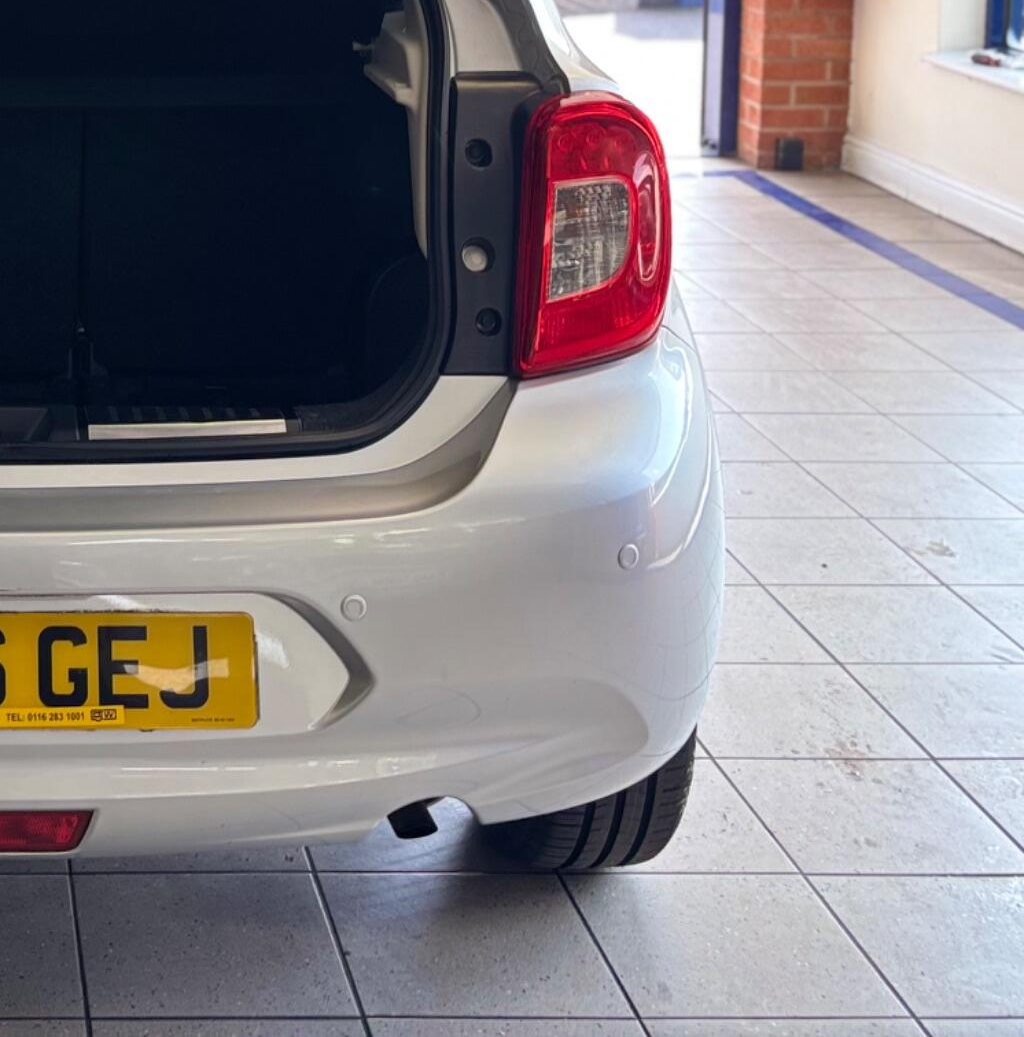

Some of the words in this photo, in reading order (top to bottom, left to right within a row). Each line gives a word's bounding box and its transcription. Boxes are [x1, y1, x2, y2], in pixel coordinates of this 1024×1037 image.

[38, 625, 209, 709] GEJ
[27, 711, 47, 721] 0116
[49, 711, 64, 721] 283
[66, 711, 85, 721] 1001
